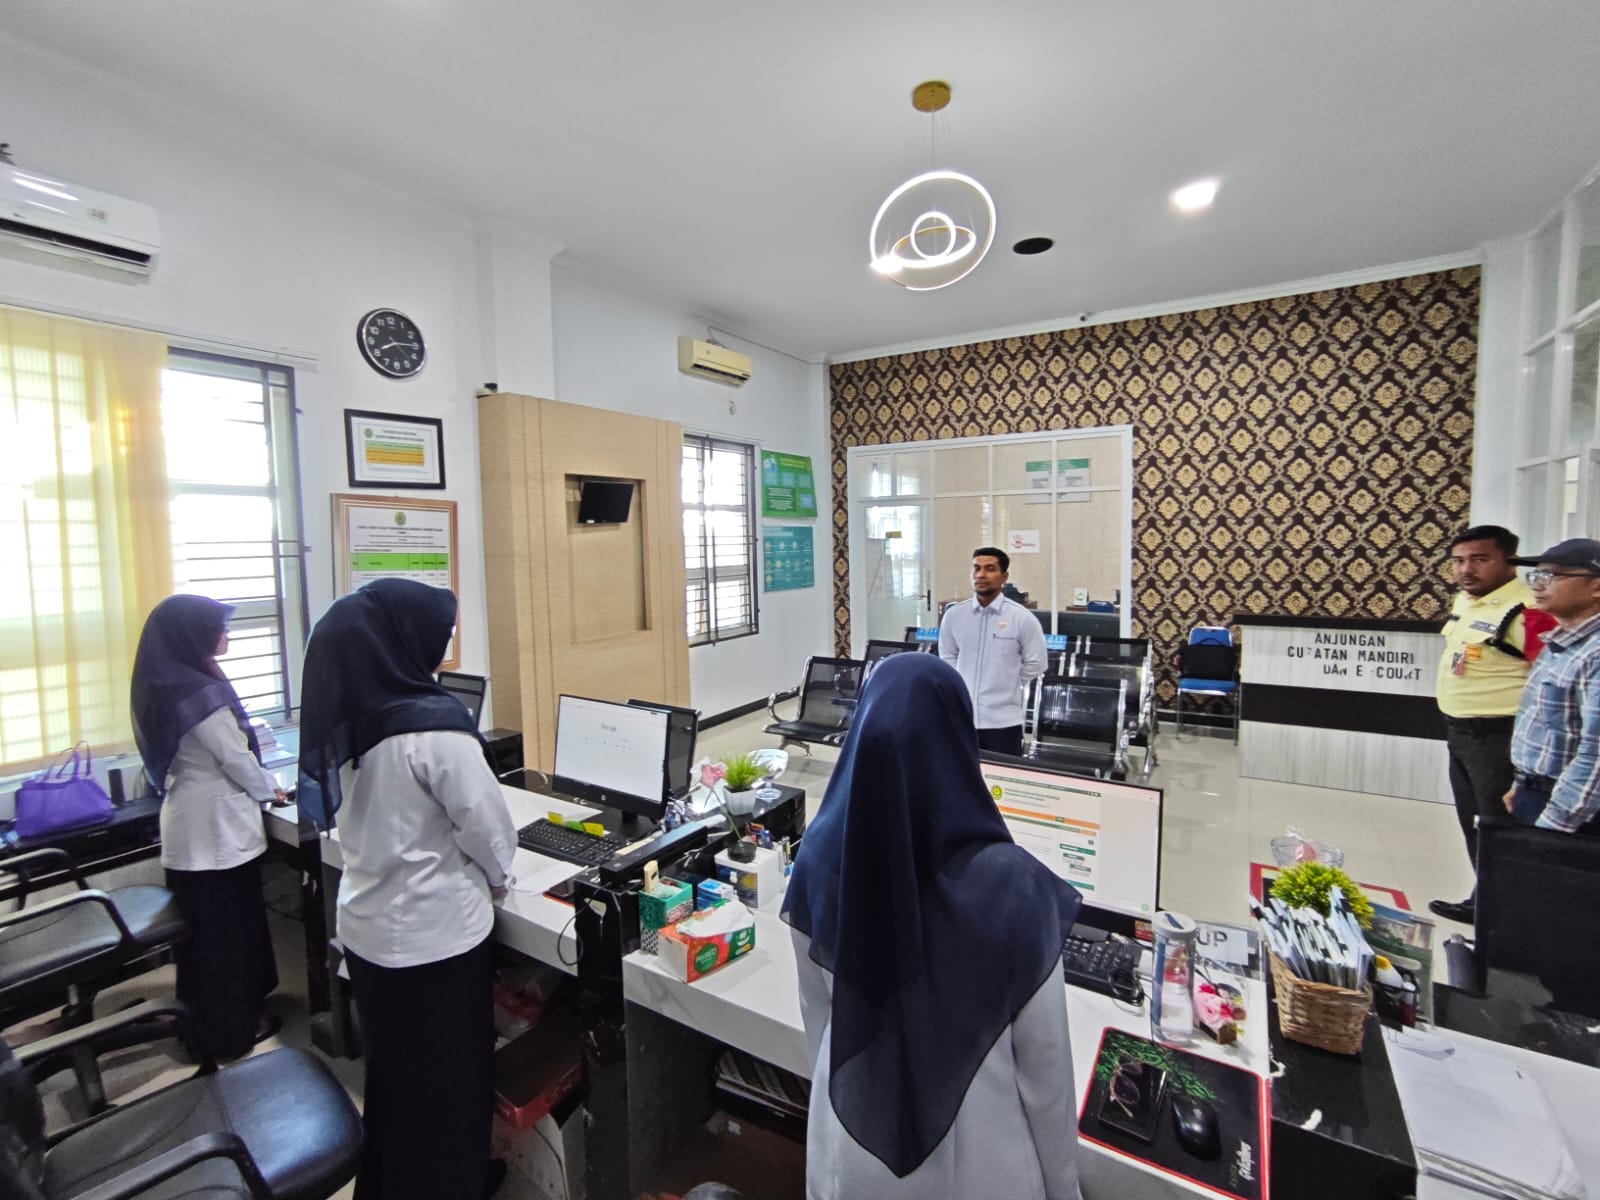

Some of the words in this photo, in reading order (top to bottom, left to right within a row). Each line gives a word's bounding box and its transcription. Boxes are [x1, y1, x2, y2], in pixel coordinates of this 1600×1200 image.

[377, 318, 385, 327] 11
[387, 316, 396, 325] 12
[369, 326, 380, 335] 10
[407, 330, 415, 339] 2
[368, 336, 375, 345] 9
[412, 342, 419, 350] 3
[374, 348, 381, 357] 8
[411, 352, 417, 360] 4
[384, 358, 390, 366] 7
[393, 361, 401, 370] 6
[403, 360, 410, 369] 5
[1314, 632, 1386, 647] ANJUNGAN
[1287, 646, 1348, 661] CUATAN
[1357, 649, 1415, 665] MANDIRI
